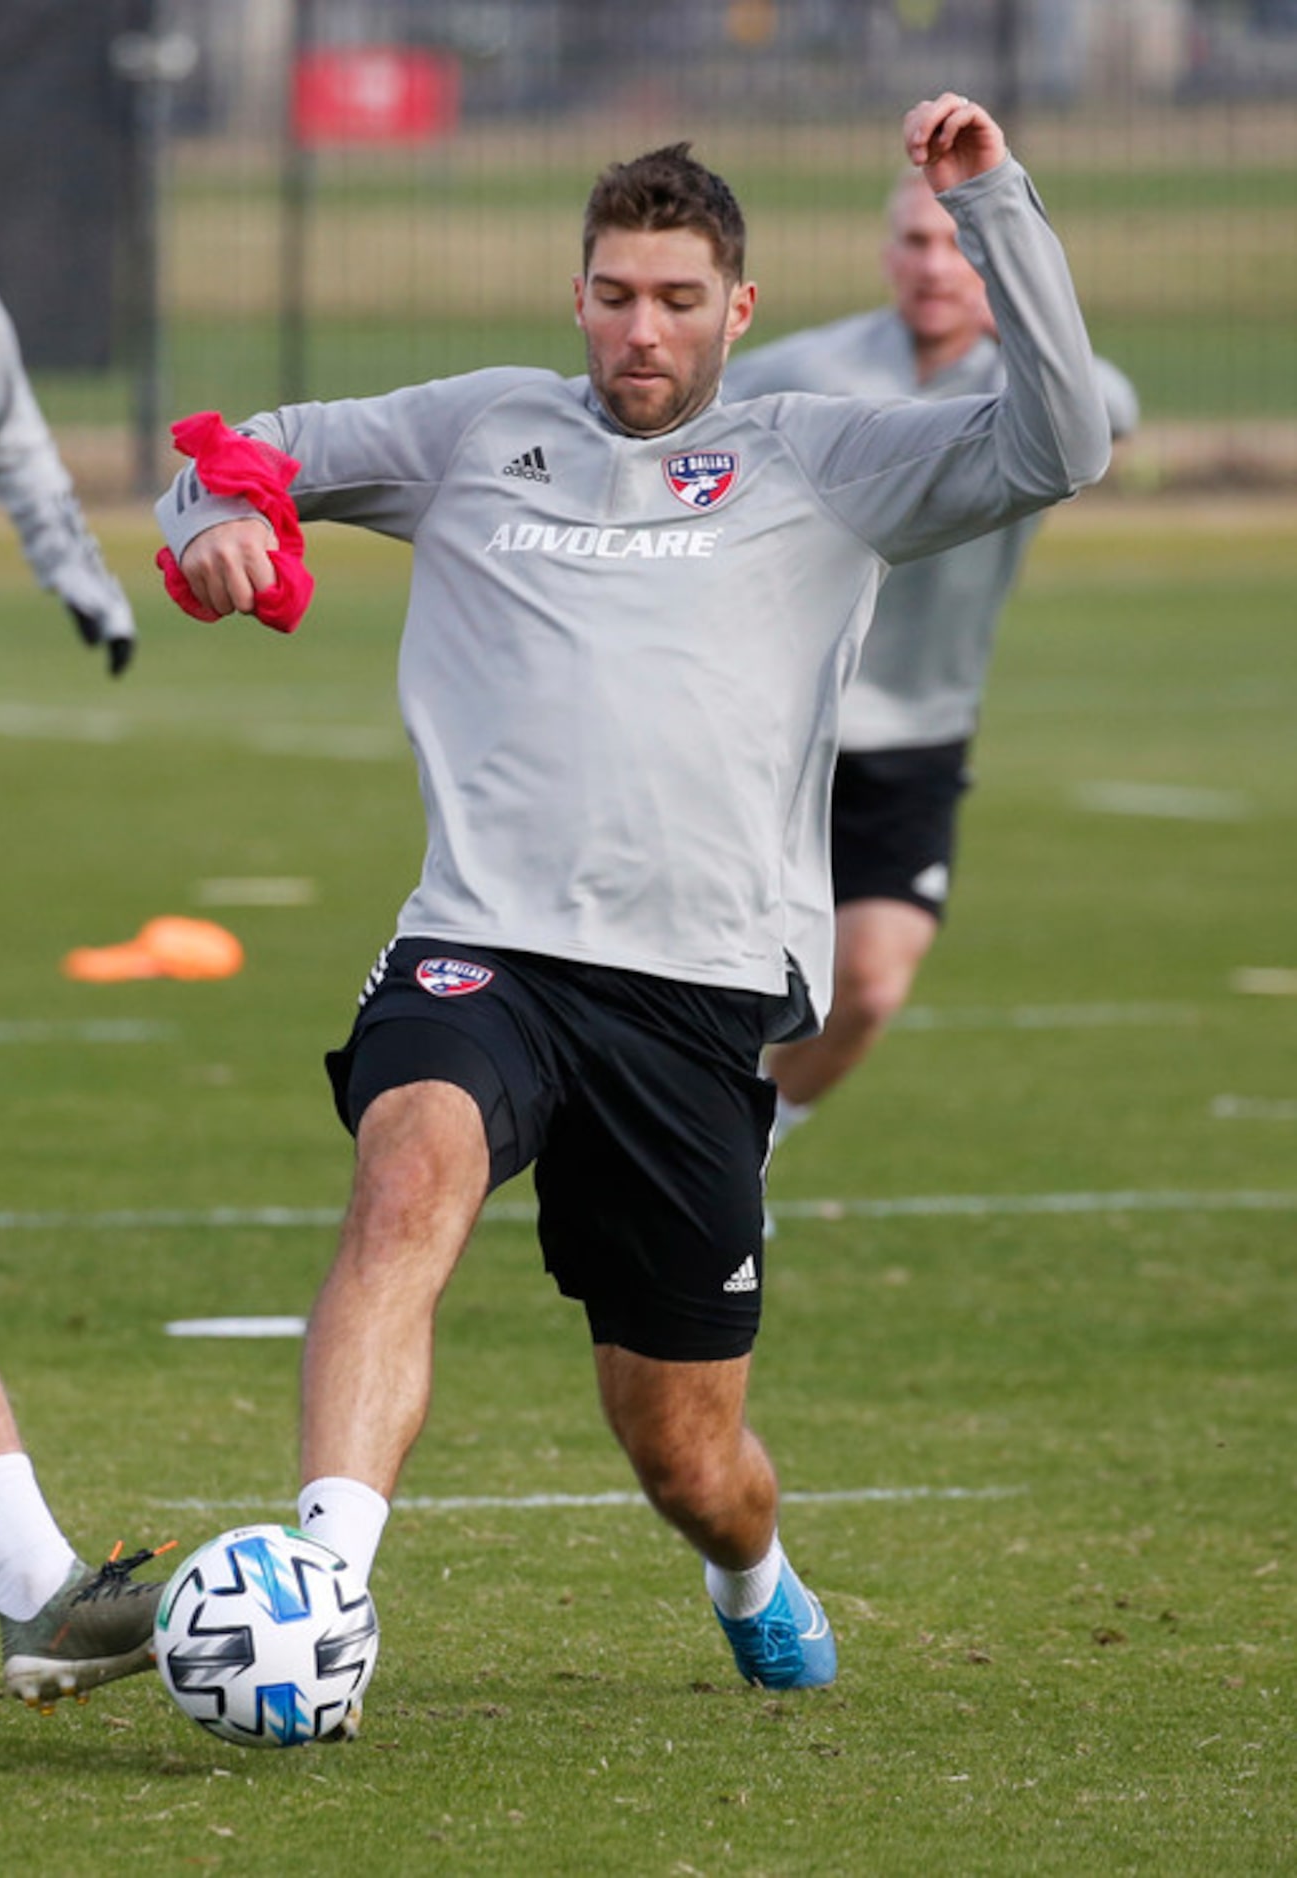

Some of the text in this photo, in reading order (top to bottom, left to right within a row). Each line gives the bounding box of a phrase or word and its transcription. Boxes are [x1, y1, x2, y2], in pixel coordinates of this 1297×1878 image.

[687, 454, 731, 471] DALLAS
[502, 465, 552, 484] adidas
[484, 522, 720, 560] ADVOCARE
